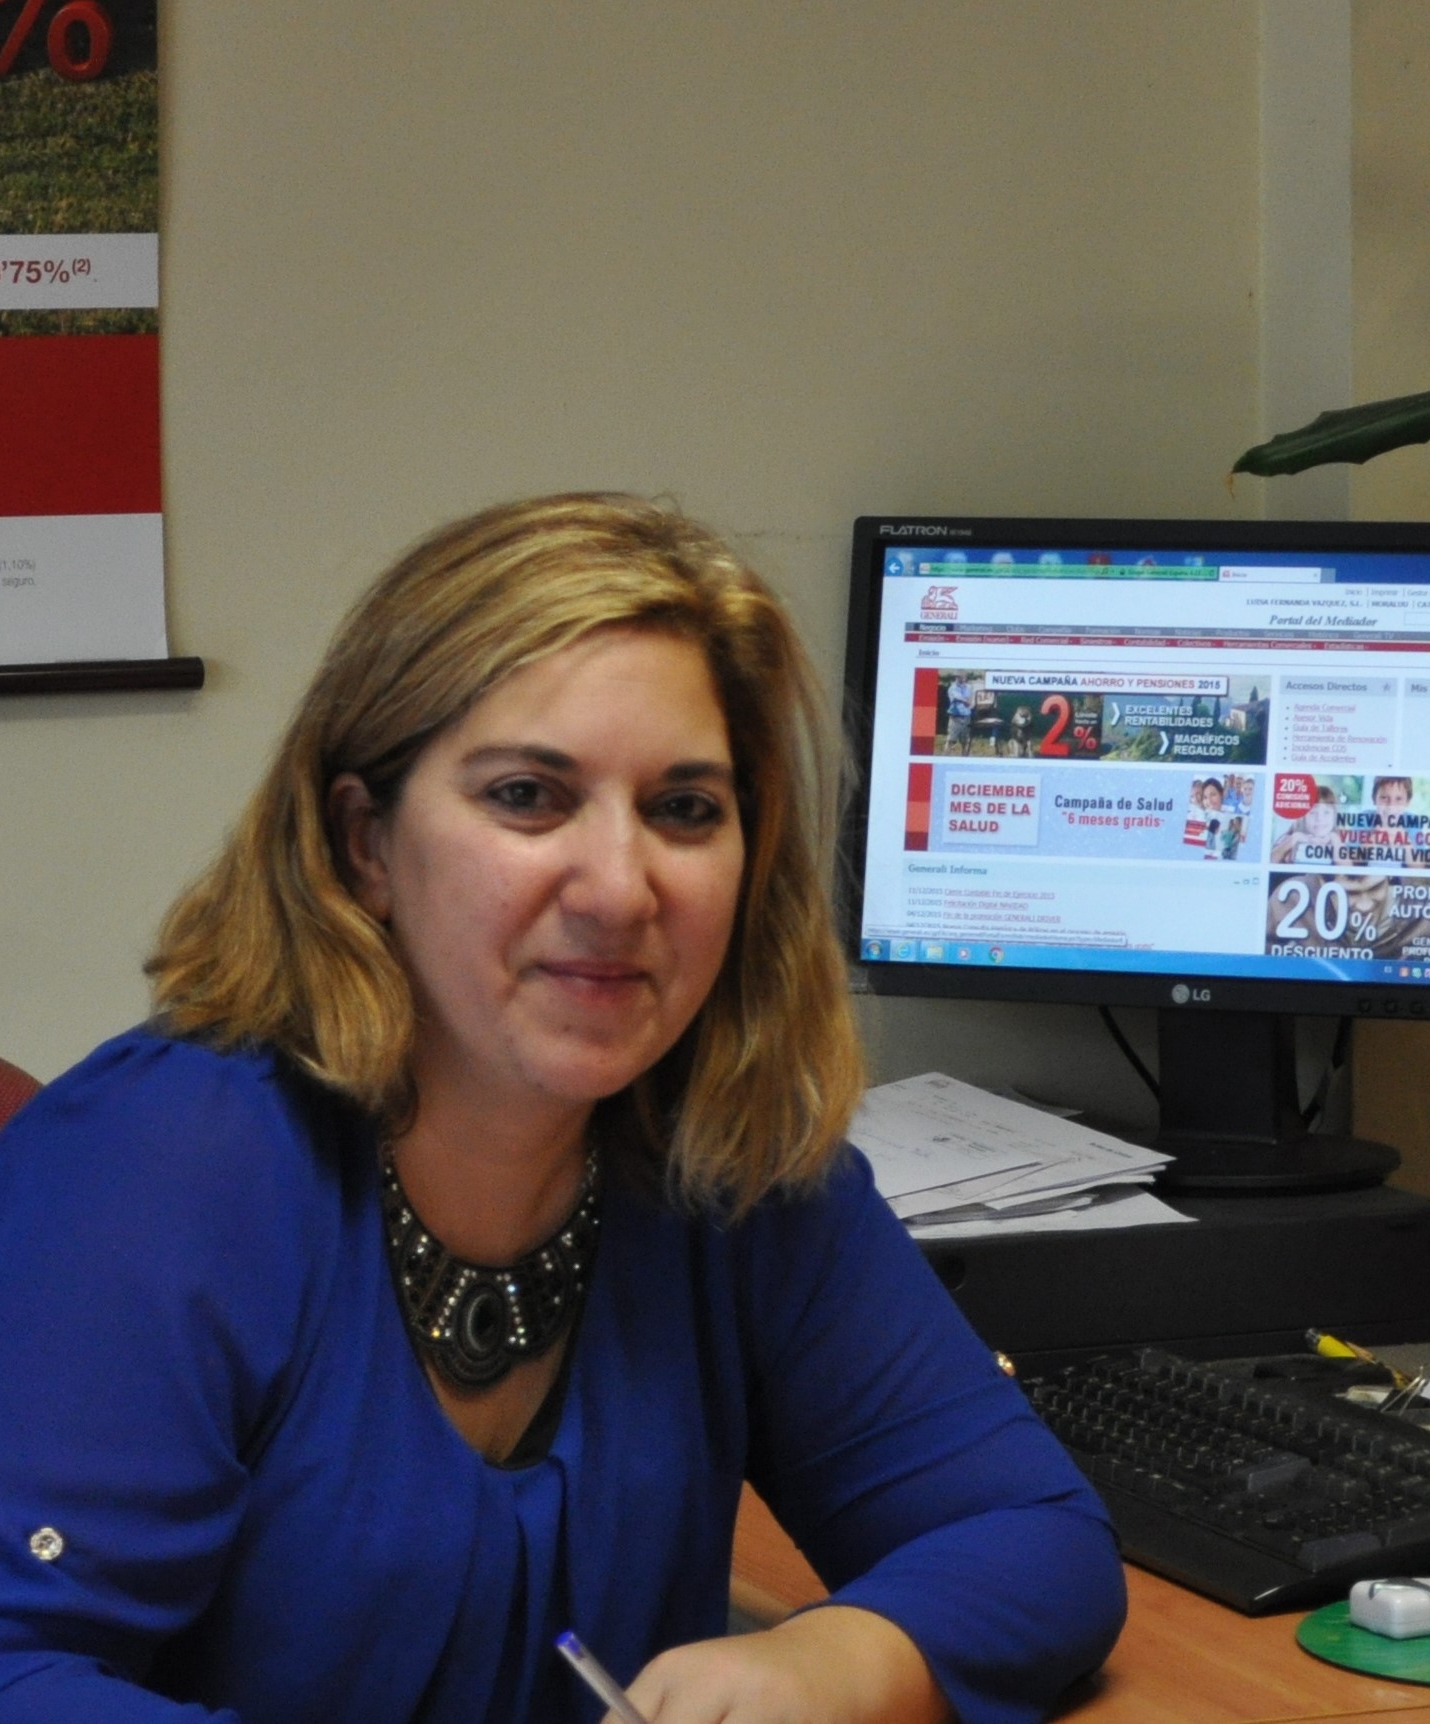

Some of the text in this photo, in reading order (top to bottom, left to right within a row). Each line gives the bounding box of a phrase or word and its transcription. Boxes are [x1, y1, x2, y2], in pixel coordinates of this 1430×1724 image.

[879, 524, 948, 536] FLATRON
[920, 611, 958, 620] GENERALI
[1269, 615, 1378, 627] Portal del Mediador
[991, 675, 1221, 690] NUEVA CAMPAÑA AHORRO Y PENSIONES 2015
[1285, 681, 1368, 691] Accesos Directos
[1411, 684, 1428, 693] Mis
[1125, 704, 1193, 717] EXCELENTES
[1124, 715, 1214, 729] RENTABILIDADES
[1174, 731, 1240, 746] MAGNÍFICOS
[1173, 745, 1225, 757] REGALOS
[950, 783, 1036, 798] DICIEMBRE
[1279, 778, 1308, 793] 20%
[949, 802, 1031, 816] MES DE LA
[1054, 794, 1174, 812] Campaña de Salud
[948, 819, 1000, 834] SALUD
[1078, 815, 1121, 826] meses
[1336, 812, 1383, 828] NUEVA
[1339, 829, 1390, 845] VUELTA
[1393, 830, 1411, 846] AL
[1305, 845, 1334, 859] CON
[1338, 845, 1406, 862] GENERALI
[907, 863, 988, 875] Generali Informa
[1271, 944, 1375, 960] DESCUENTO
[1192, 988, 1211, 1002] LG
